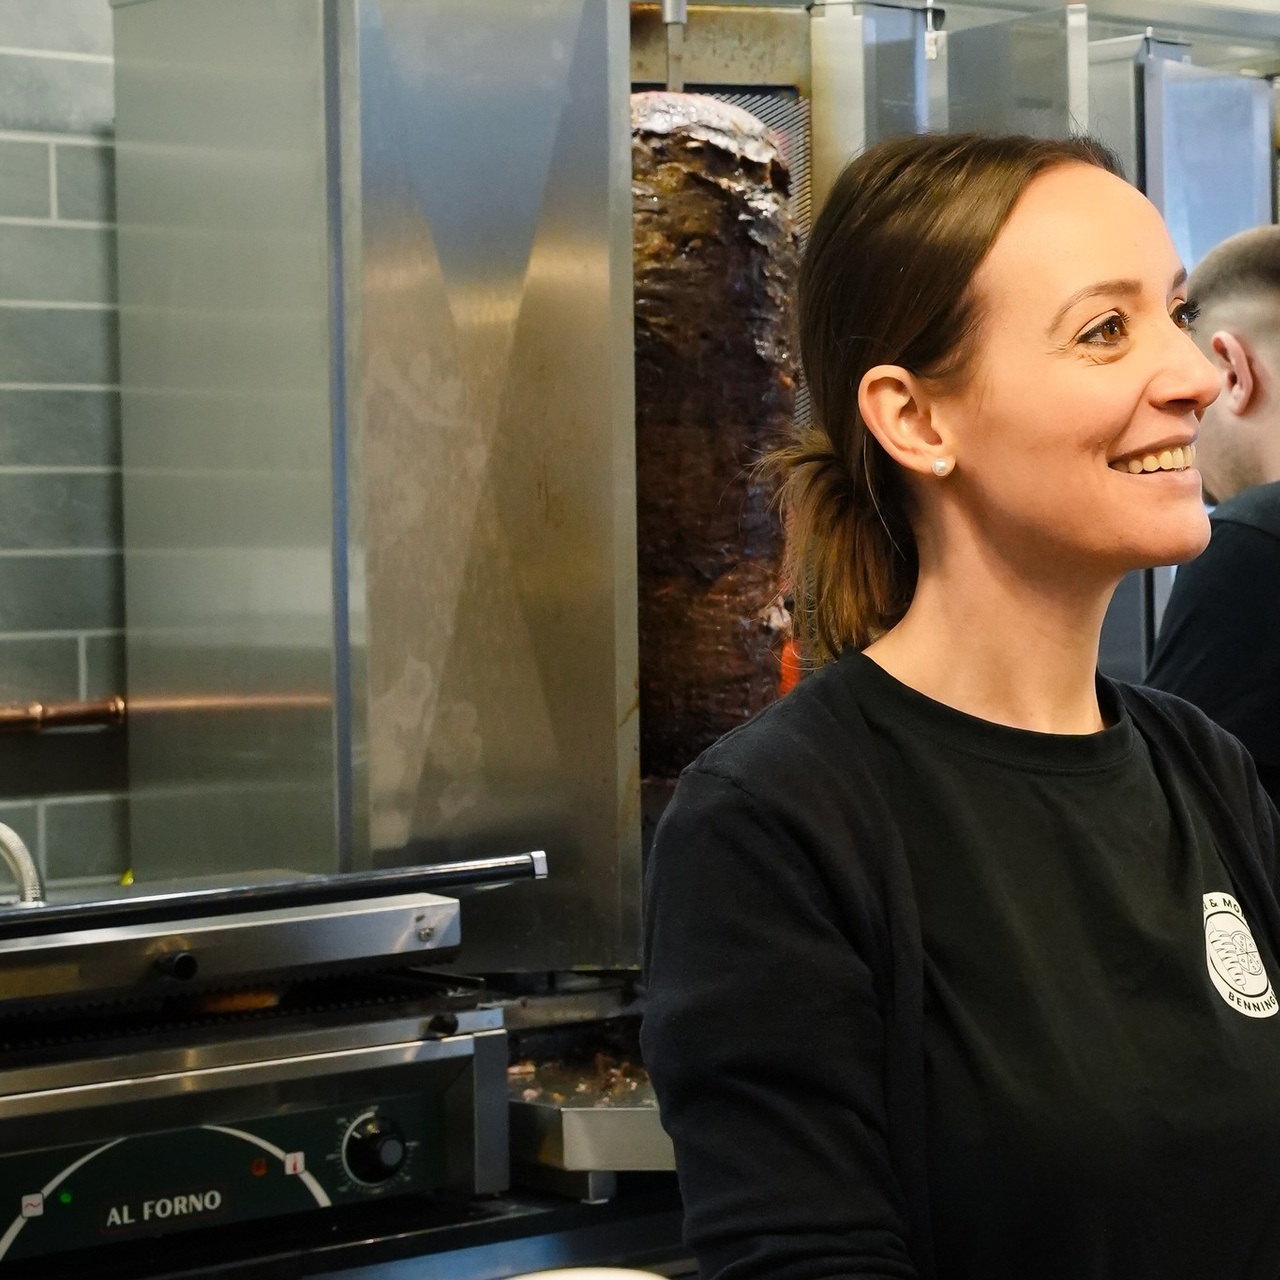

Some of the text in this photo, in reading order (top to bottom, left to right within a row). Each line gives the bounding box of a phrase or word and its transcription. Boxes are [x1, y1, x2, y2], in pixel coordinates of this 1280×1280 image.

[1228, 991, 1276, 1012] BENNING
[106, 1190, 222, 1227] AL FORNO
